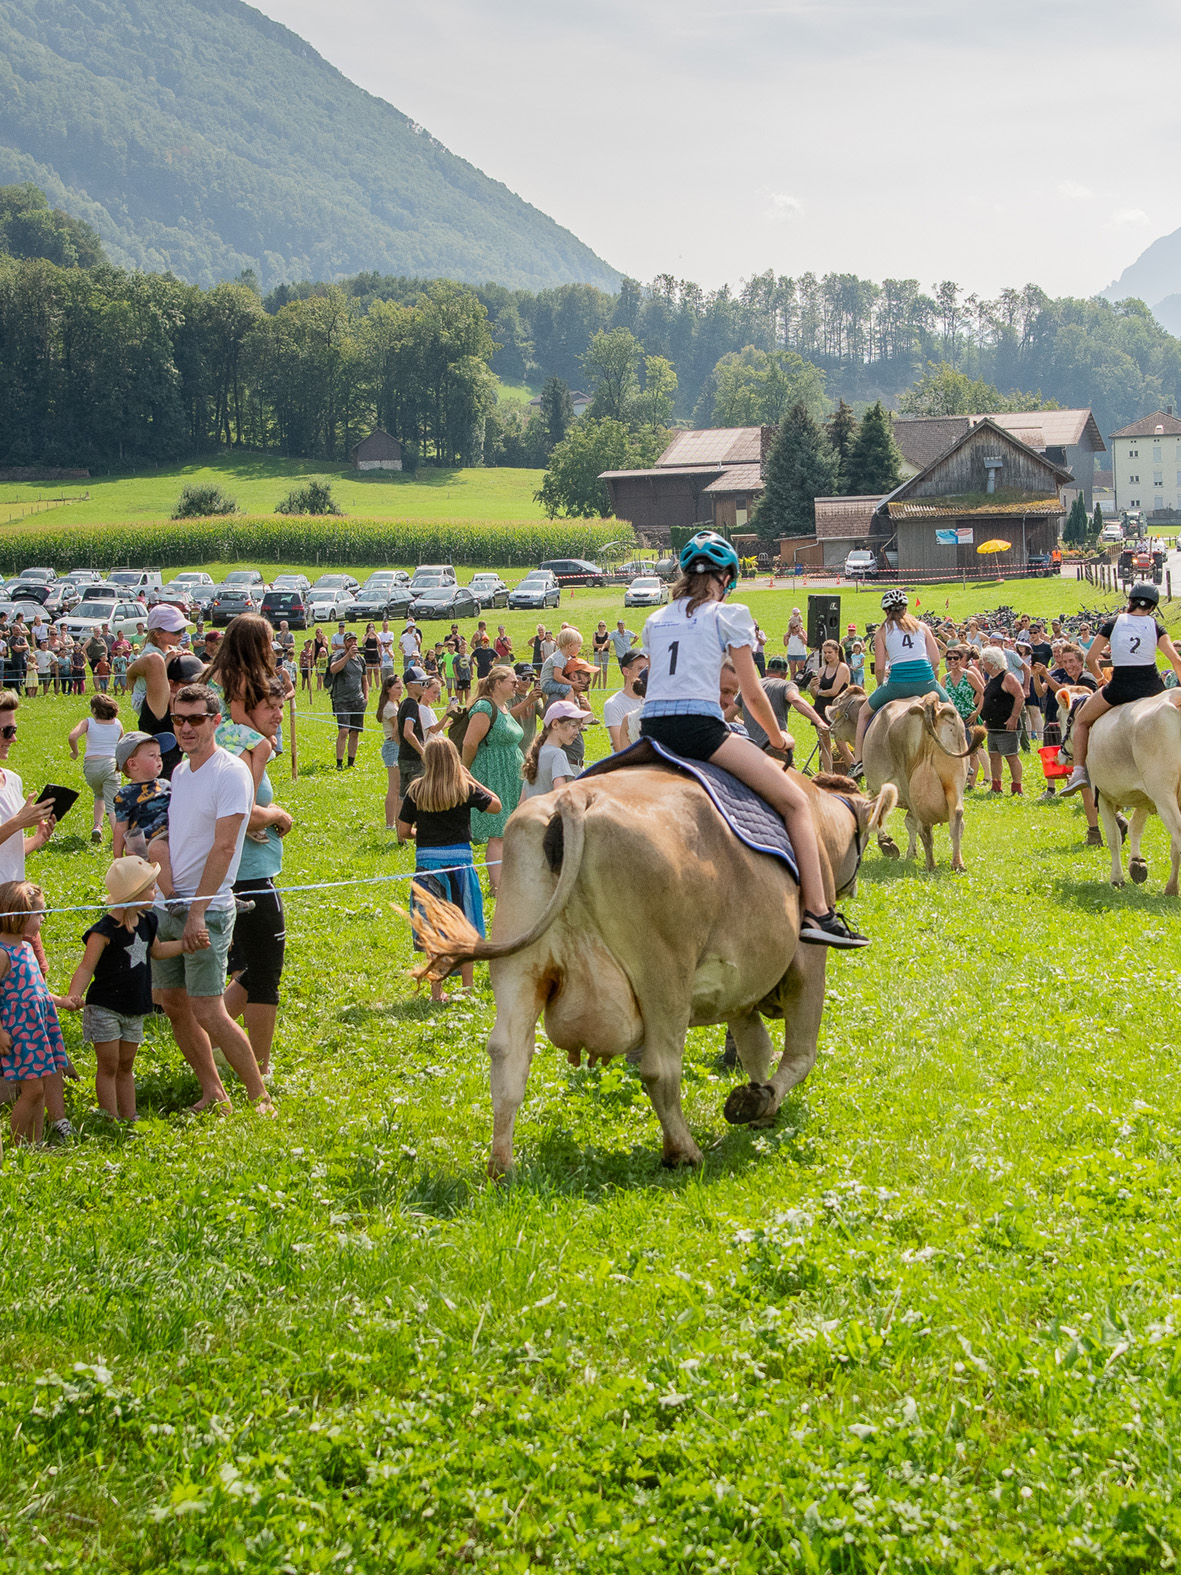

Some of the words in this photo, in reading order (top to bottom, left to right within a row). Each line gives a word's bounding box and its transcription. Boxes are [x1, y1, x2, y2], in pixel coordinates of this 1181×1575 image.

[902, 634, 914, 649] 4
[1129, 637, 1141, 654] 2
[668, 641, 679, 676] 1
